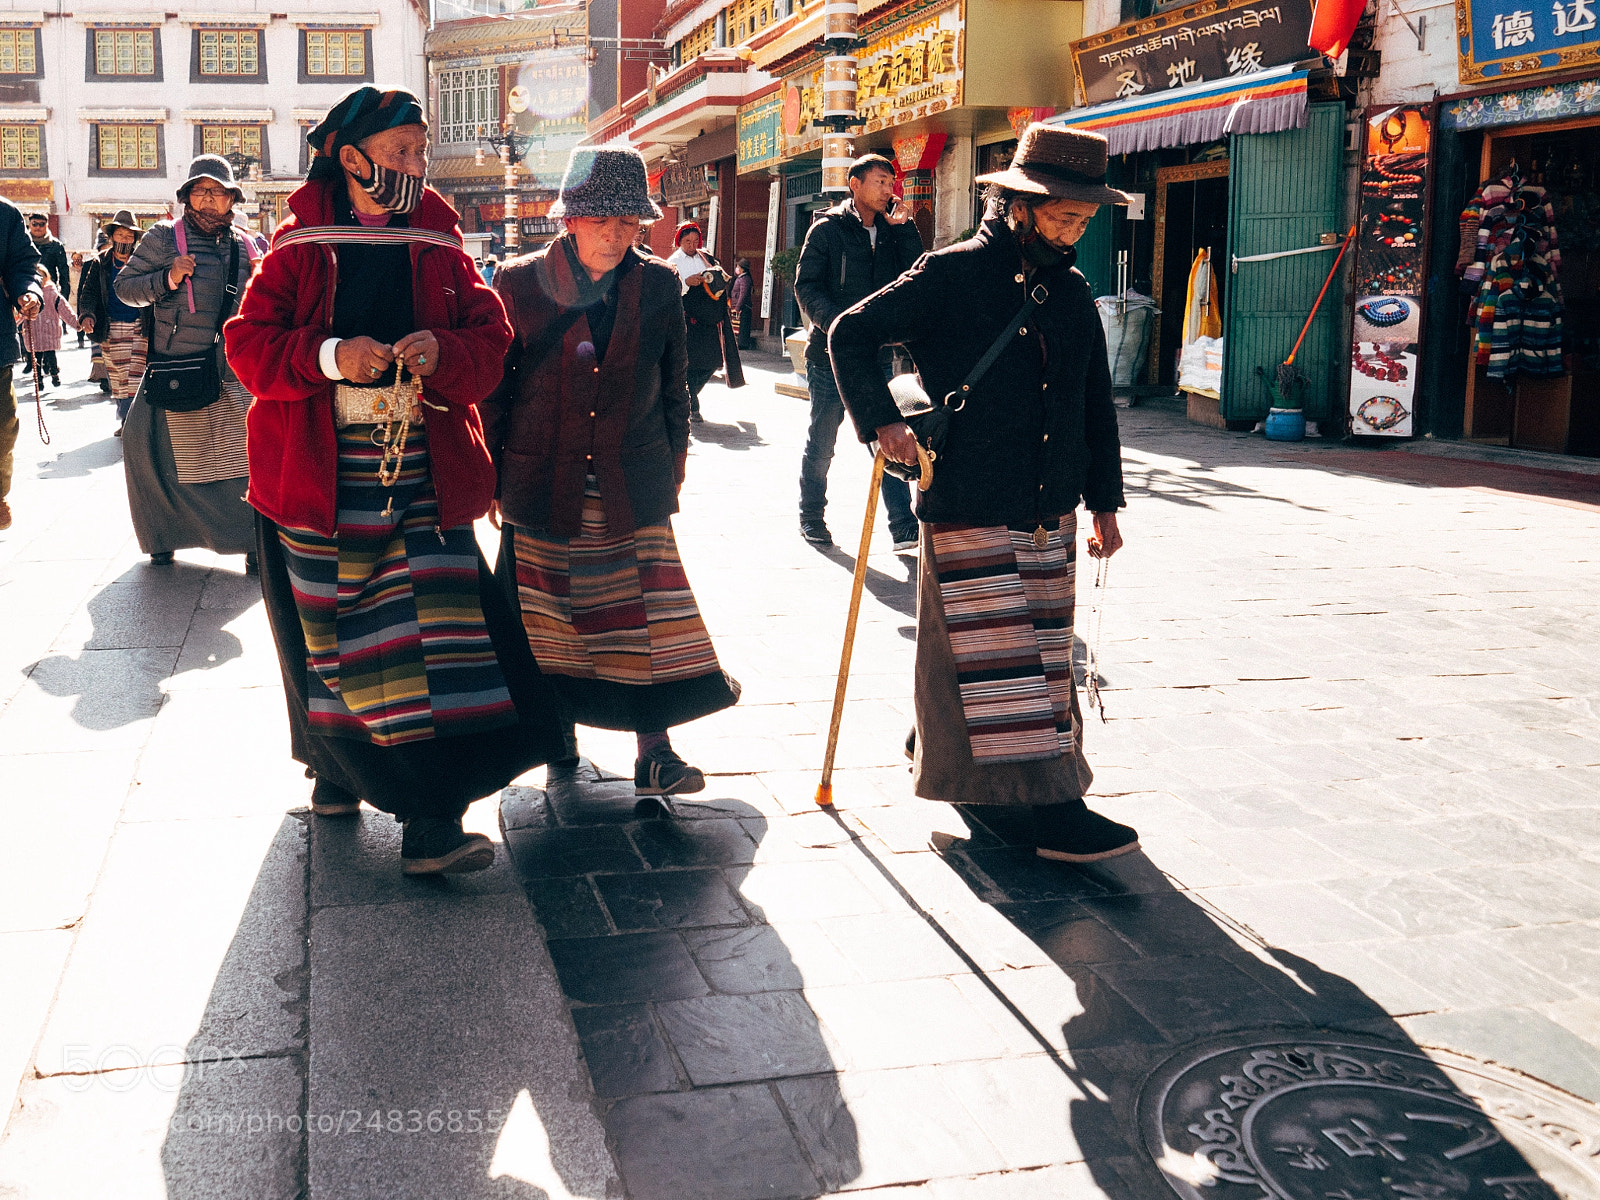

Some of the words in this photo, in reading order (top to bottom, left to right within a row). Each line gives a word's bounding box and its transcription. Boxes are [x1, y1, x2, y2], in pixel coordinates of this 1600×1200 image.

[1492, 0, 1597, 50] 德达
[1116, 42, 1266, 98] 圣地缘
